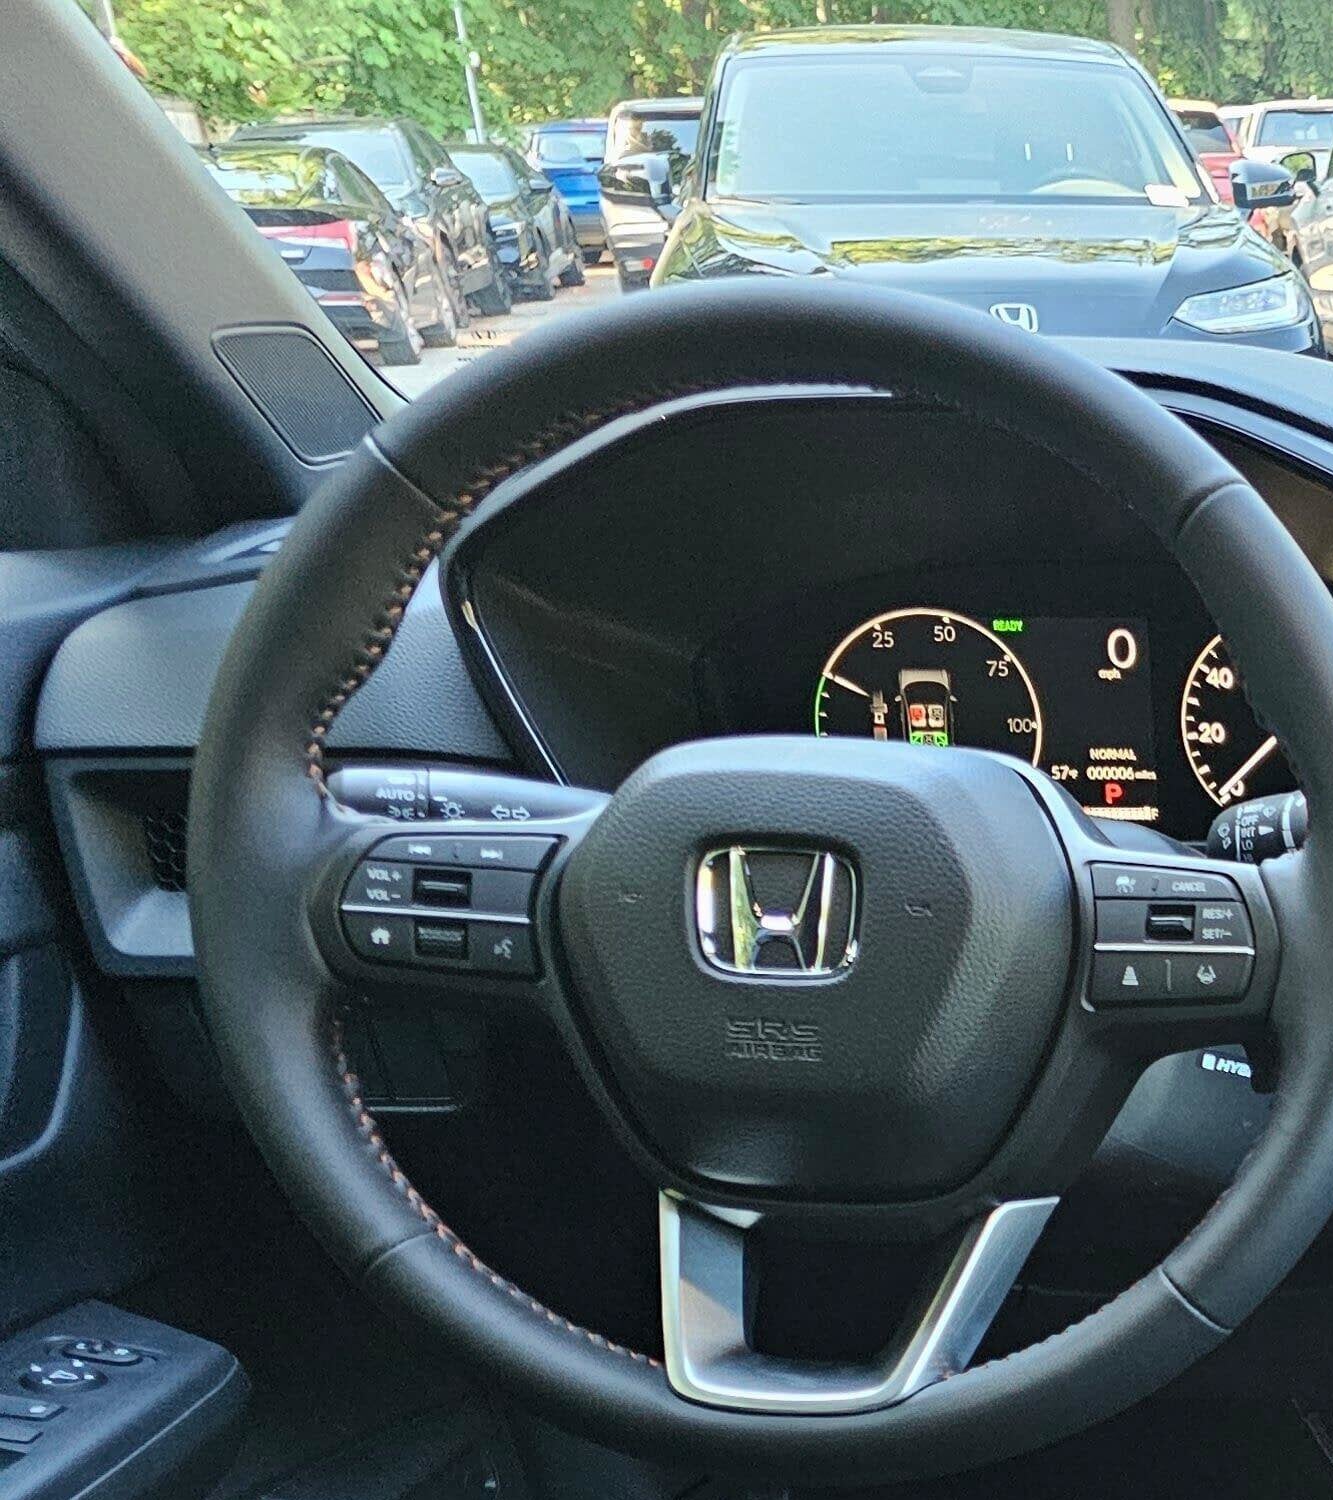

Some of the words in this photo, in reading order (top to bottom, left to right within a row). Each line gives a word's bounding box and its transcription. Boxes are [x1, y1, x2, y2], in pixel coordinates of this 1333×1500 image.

[872, 631, 894, 648] 25
[934, 626, 956, 642] 50
[1107, 628, 1137, 669] 0
[986, 660, 1009, 677] 75
[1205, 666, 1234, 690] 40
[1007, 717, 1031, 733] 100
[1198, 721, 1226, 744] 20
[1089, 748, 1137, 760] NORMAL
[1086, 766, 1134, 780] 000006
[376, 787, 415, 801] AUTO
[1105, 782, 1123, 804] P
[366, 866, 391, 881] VOL
[366, 887, 391, 900] VOL
[1172, 881, 1207, 893] CANCEL
